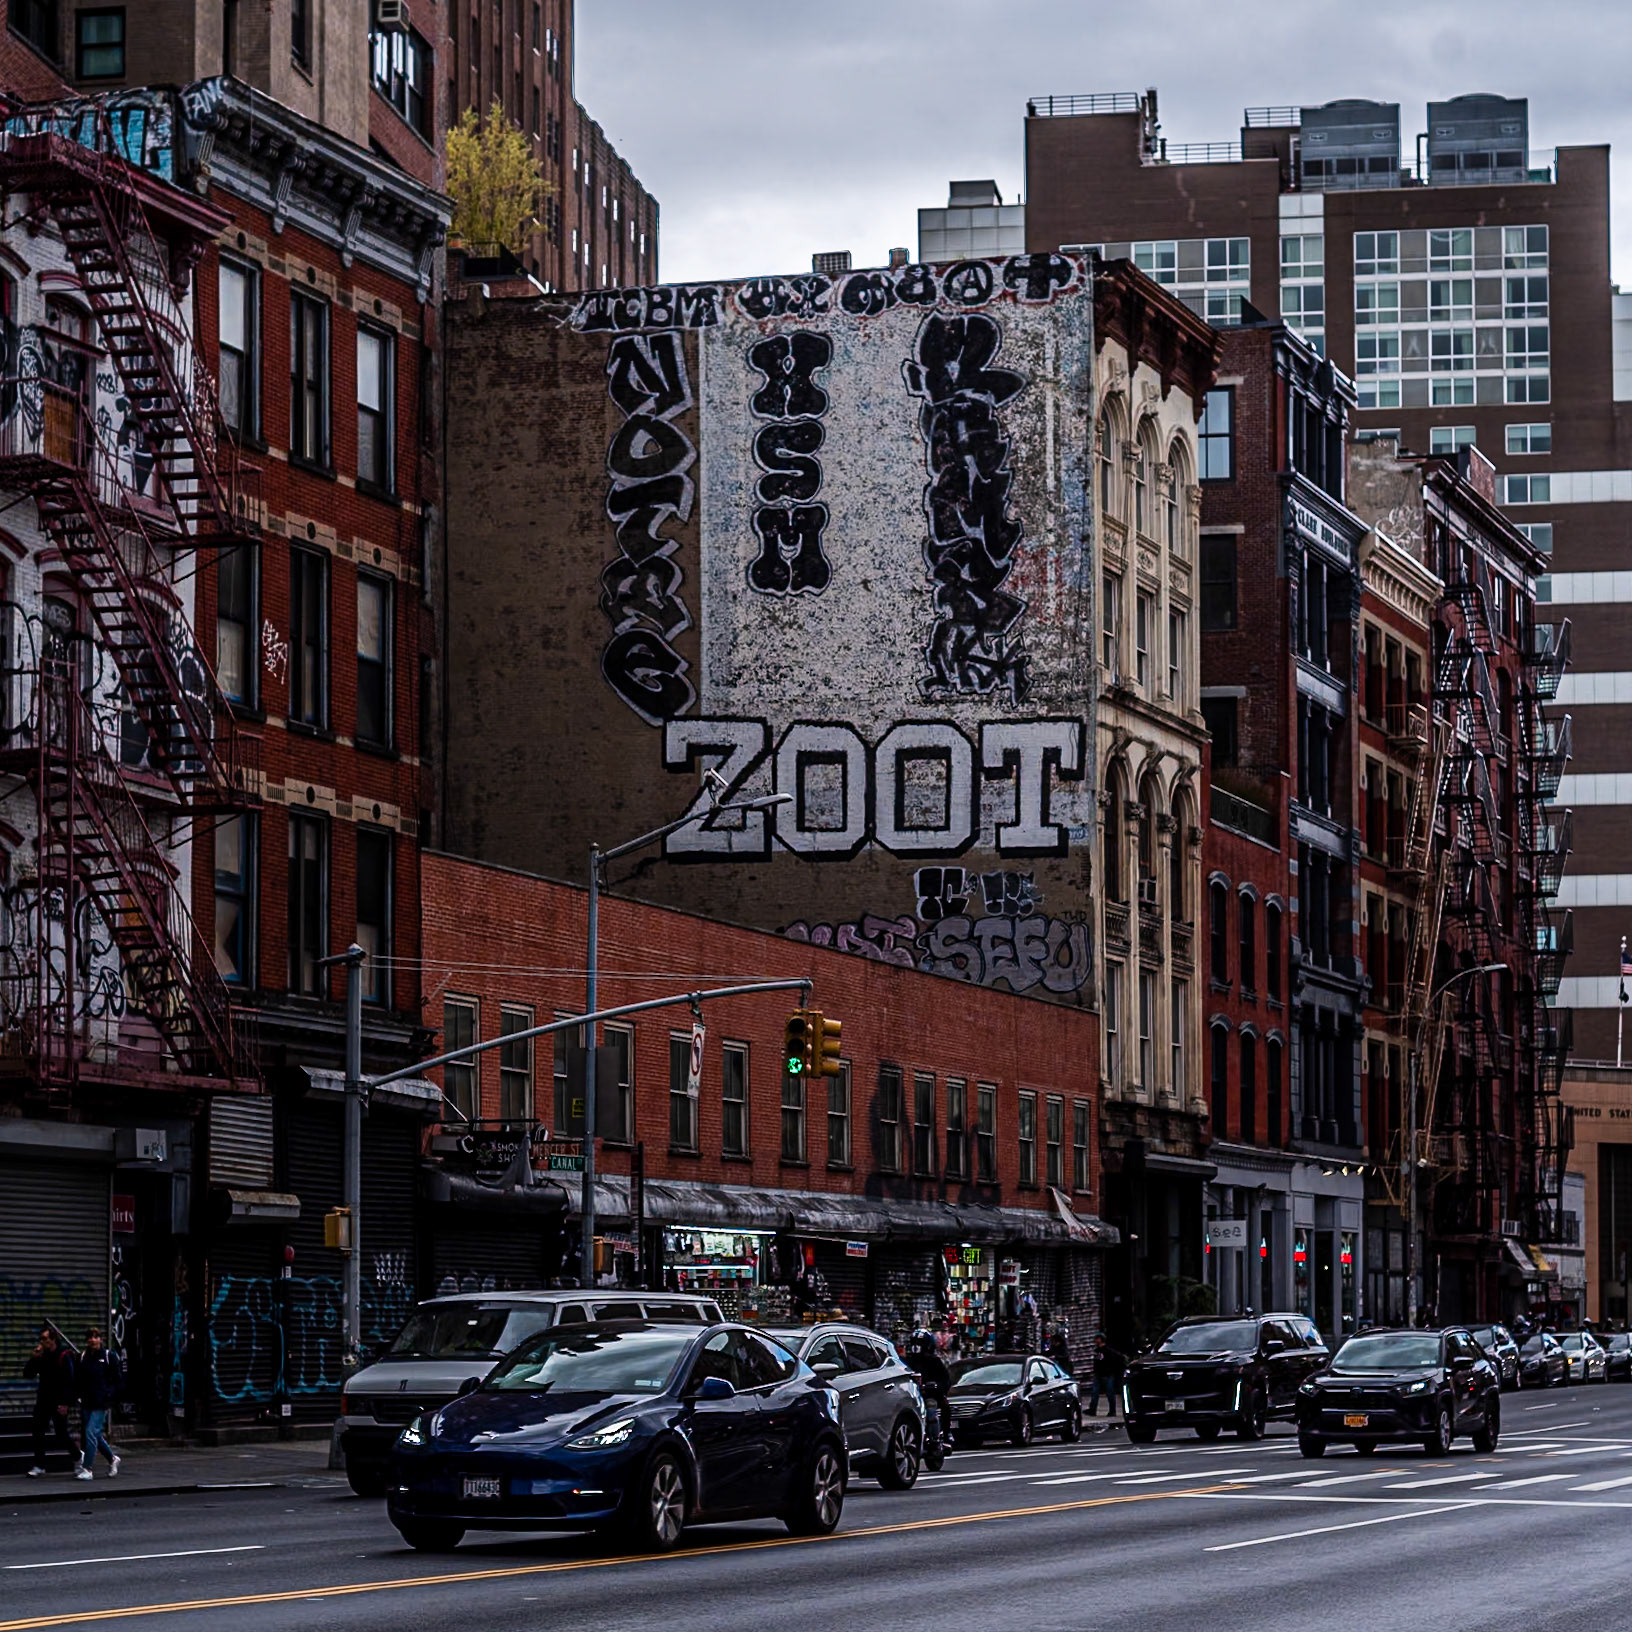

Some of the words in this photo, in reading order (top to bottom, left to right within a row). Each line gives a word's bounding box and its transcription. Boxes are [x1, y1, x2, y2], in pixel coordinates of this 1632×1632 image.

[662, 716, 1087, 862] ZOOT
[1574, 1107, 1601, 1118] NITED
[1609, 1108, 1632, 1119] STAT
[533, 1143, 566, 1157] MERCER
[570, 1144, 582, 1156] ST
[551, 1157, 577, 1171] CANAL
[112, 1208, 134, 1223] irts
